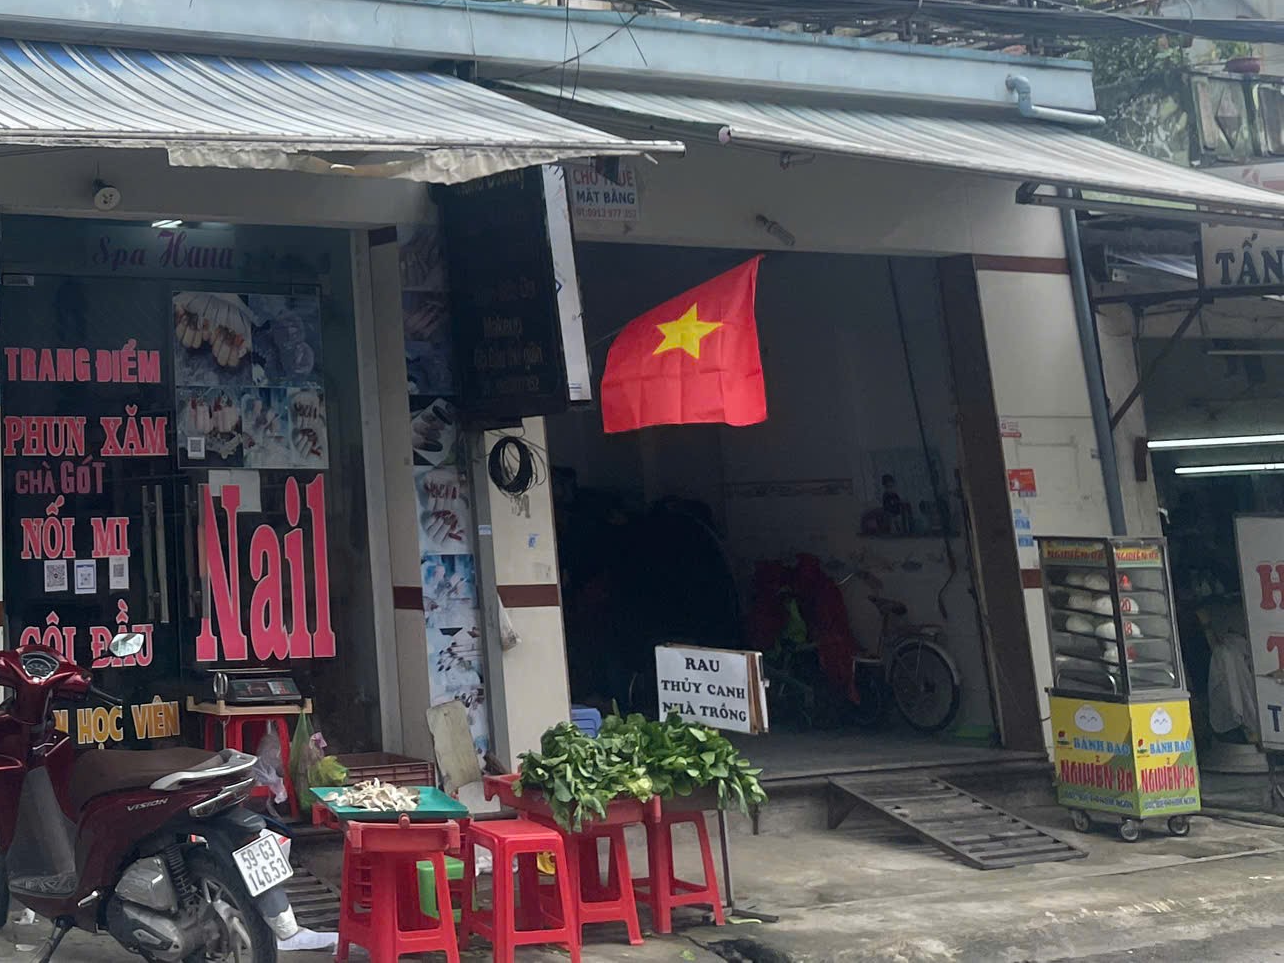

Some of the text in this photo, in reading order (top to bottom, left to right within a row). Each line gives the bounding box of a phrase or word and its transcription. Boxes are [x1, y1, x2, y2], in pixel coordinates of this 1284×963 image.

[92, 235, 147, 271] Spa
[4, 339, 161, 383] TRANG ĐIỂM
[3, 404, 169, 457] PHUN XĂM
[15, 461, 57, 494] CHÀ
[20, 496, 131, 560] NỐI MI
[196, 473, 336, 662] Nail
[684, 657, 721, 673] RAU
[661, 677, 746, 699] THỦY CANH
[77, 705, 124, 751] HỌC
[131, 694, 181, 740] VIÊN
[127, 797, 169, 812] VISION
